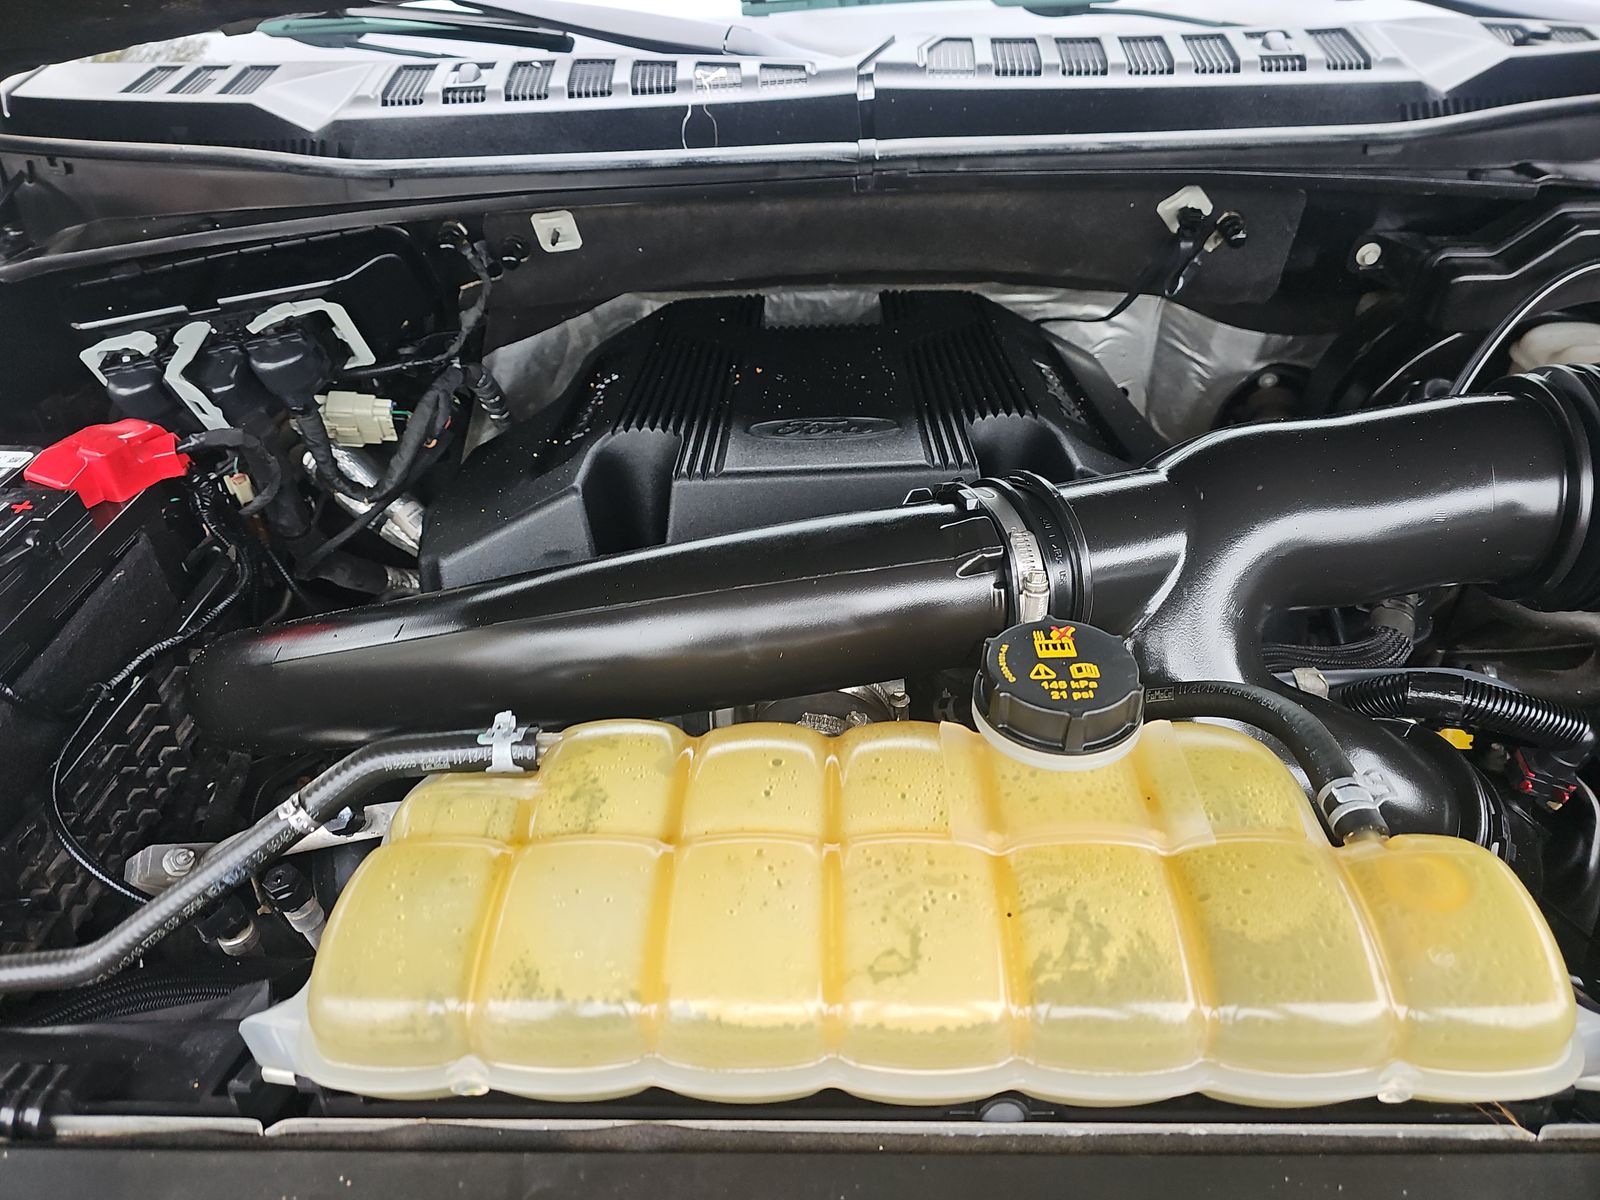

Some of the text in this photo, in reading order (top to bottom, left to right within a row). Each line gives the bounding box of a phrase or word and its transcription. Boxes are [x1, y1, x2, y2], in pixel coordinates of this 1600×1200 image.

[1069, 679, 1098, 689] kPa
[1049, 689, 1095, 701] 21 psi
[1147, 687, 1172, 700] FoMoCo
